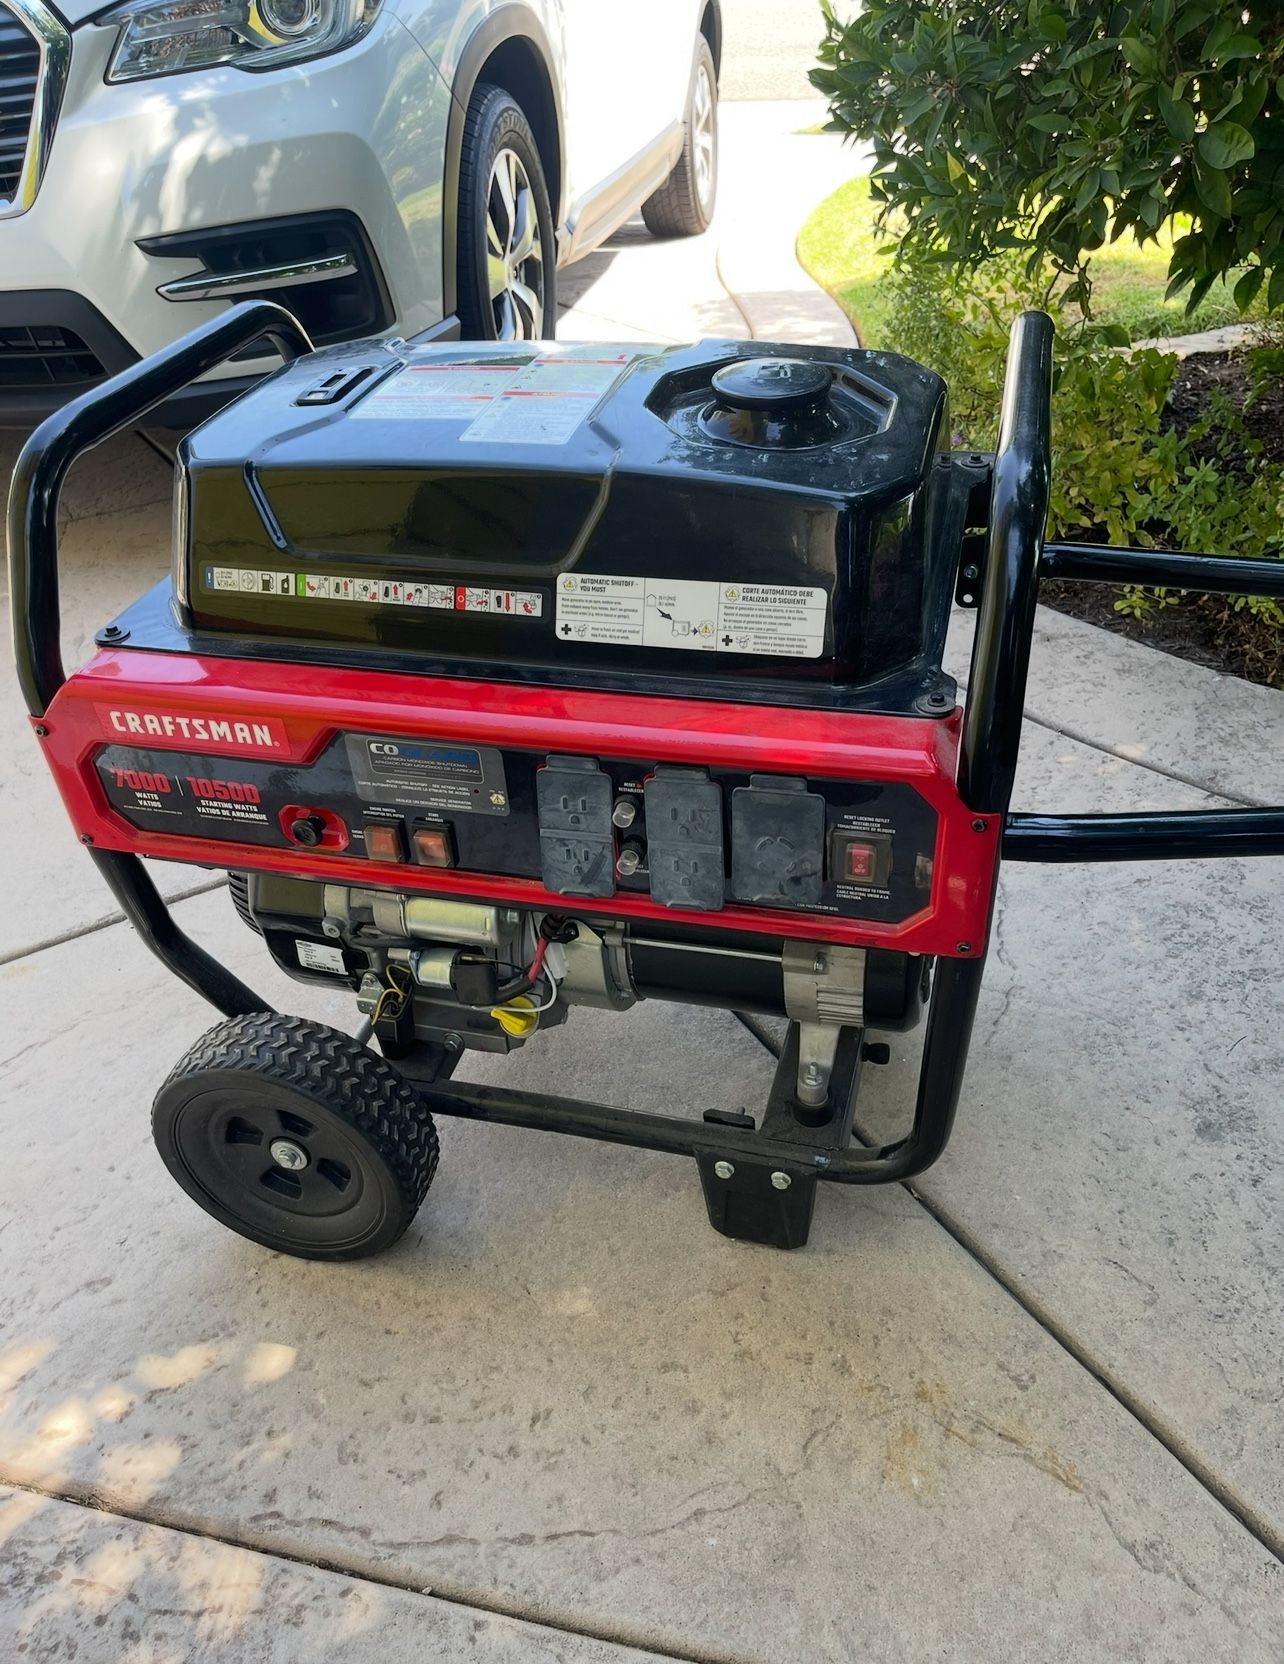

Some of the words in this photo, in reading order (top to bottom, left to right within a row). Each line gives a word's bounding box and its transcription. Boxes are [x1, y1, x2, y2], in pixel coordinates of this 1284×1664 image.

[580, 577, 610, 586] AUTOMATIC
[742, 587, 760, 595] CORTE
[761, 587, 798, 597] AUTOMÁTICO
[742, 595, 769, 603] REALIZAR
[778, 597, 807, 605] SIGUIENTE
[110, 710, 273, 747] CRAFTSMAN
[369, 742, 399, 756] CO
[110, 767, 171, 793] 7000
[135, 791, 159, 800] WATTS
[187, 776, 261, 803] 10500
[138, 799, 162, 808] VATIOS
[200, 799, 233, 809] STARTING
[233, 803, 257, 812] WATTS
[196, 806, 220, 815] VATIOS
[221, 808, 231, 816] DE
[232, 810, 268, 821] ARRANQUE
